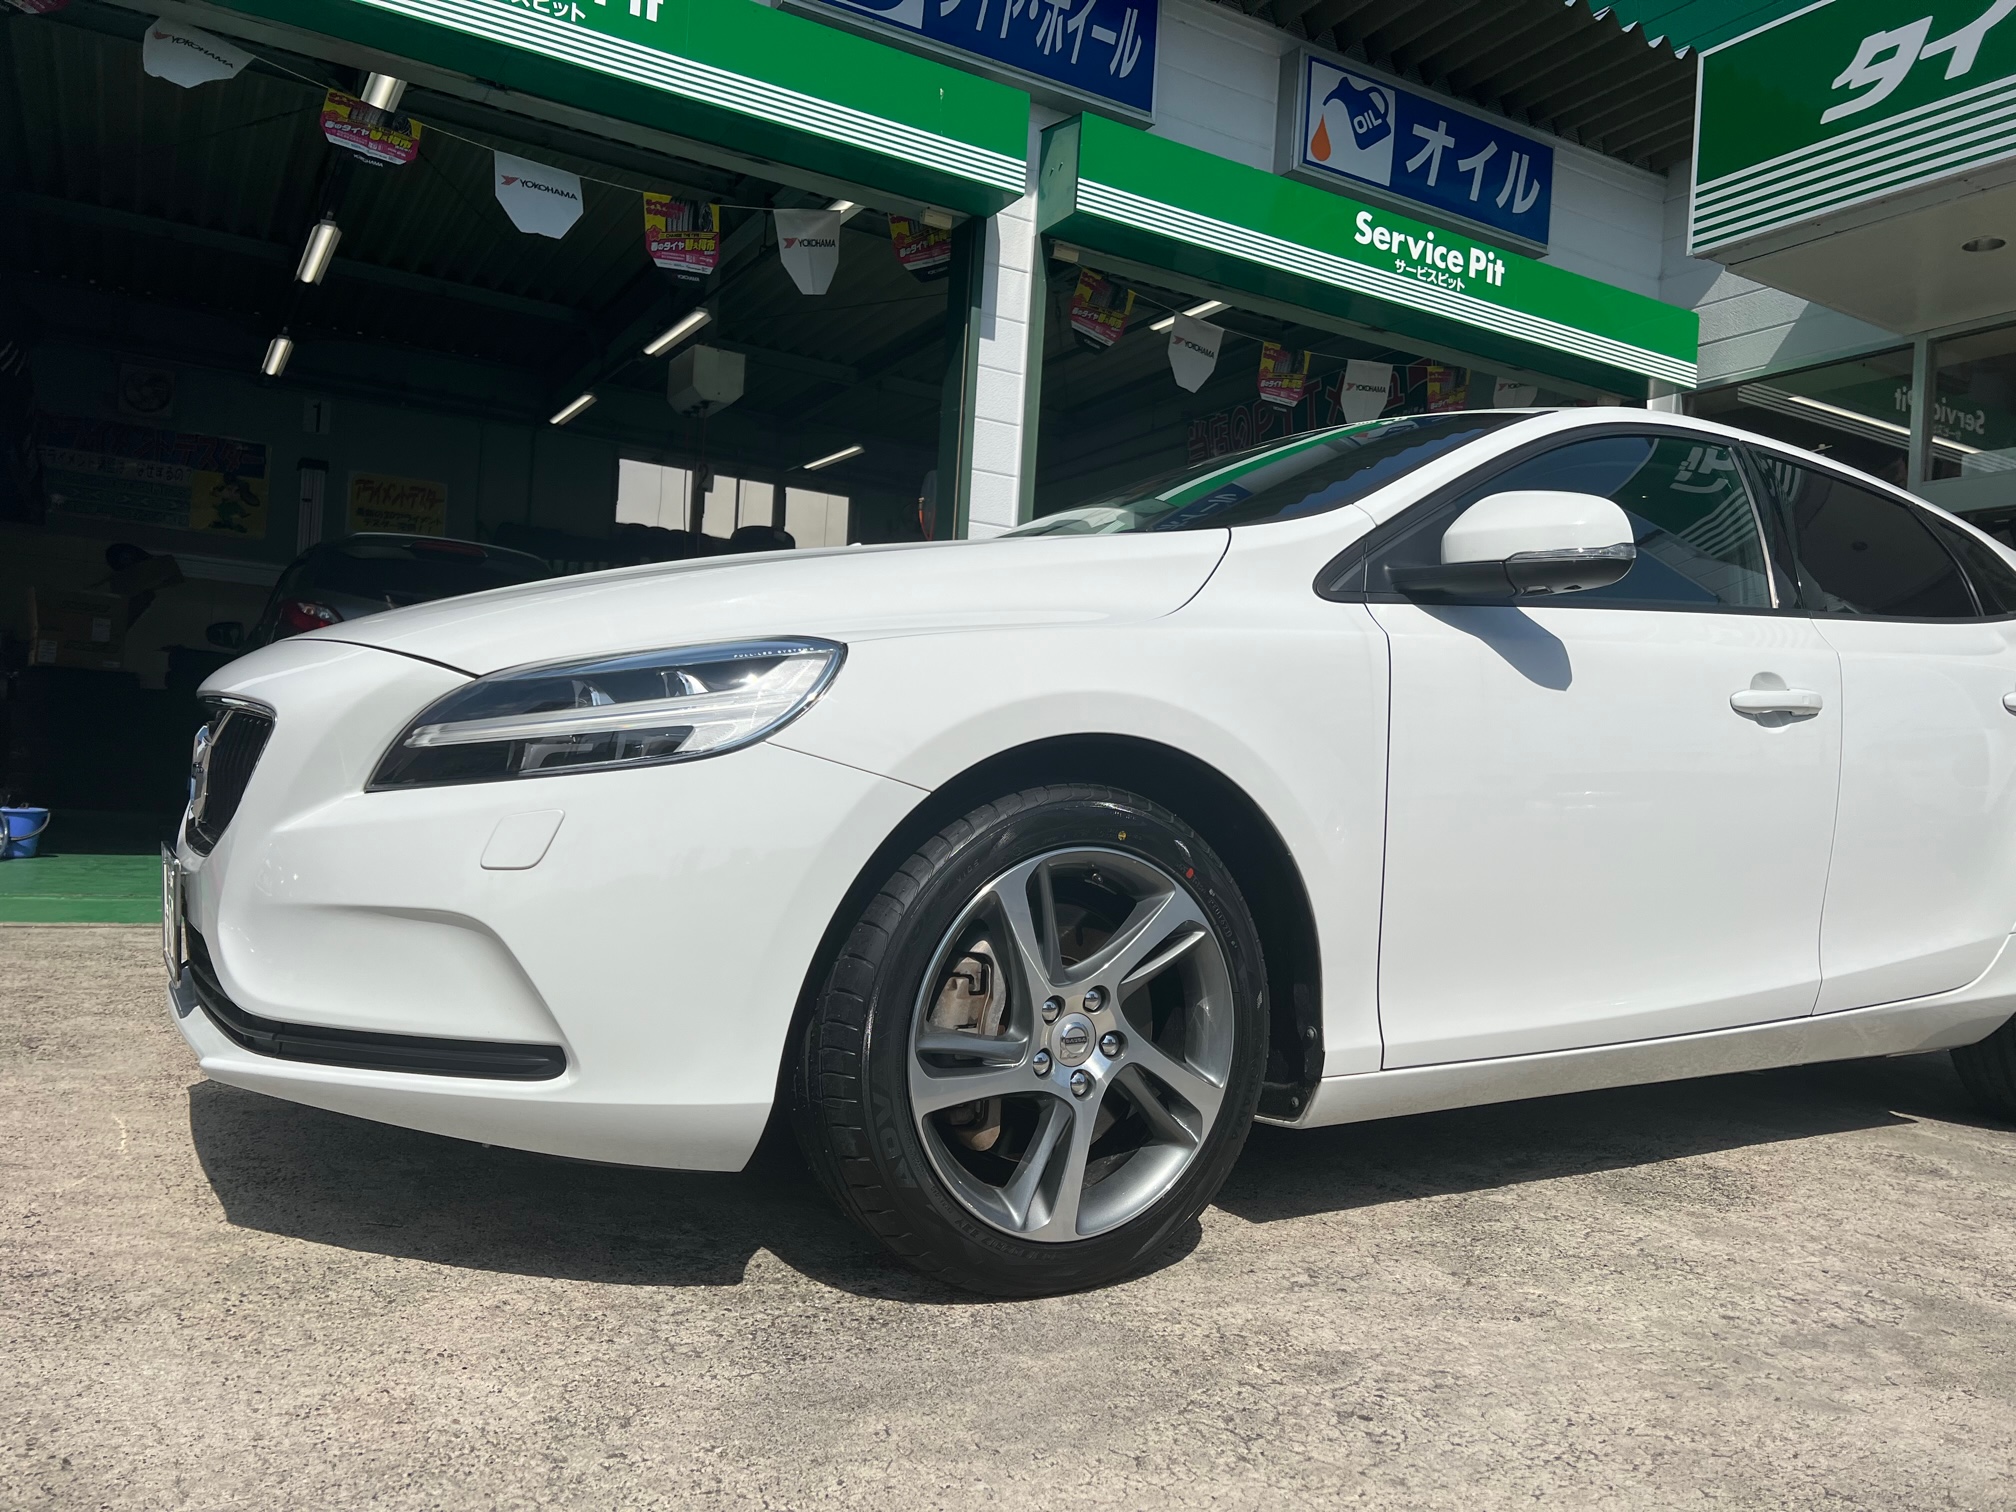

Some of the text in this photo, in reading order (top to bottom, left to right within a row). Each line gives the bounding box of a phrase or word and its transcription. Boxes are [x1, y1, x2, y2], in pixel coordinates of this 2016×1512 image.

[171, 36, 233, 68] YOKOHAMA
[1354, 110, 1383, 135] OIL
[1406, 120, 1540, 214] オイル
[520, 179, 578, 201] YOKOHAMA
[798, 239, 836, 248] YOKOHAMA
[1354, 211, 1505, 287] Service Pit
[1395, 259, 1465, 291] サービスピット
[1184, 338, 1215, 359] YOKOHAMA
[1356, 385, 1386, 393] YOKOHAMA
[313, 402, 321, 432] 1
